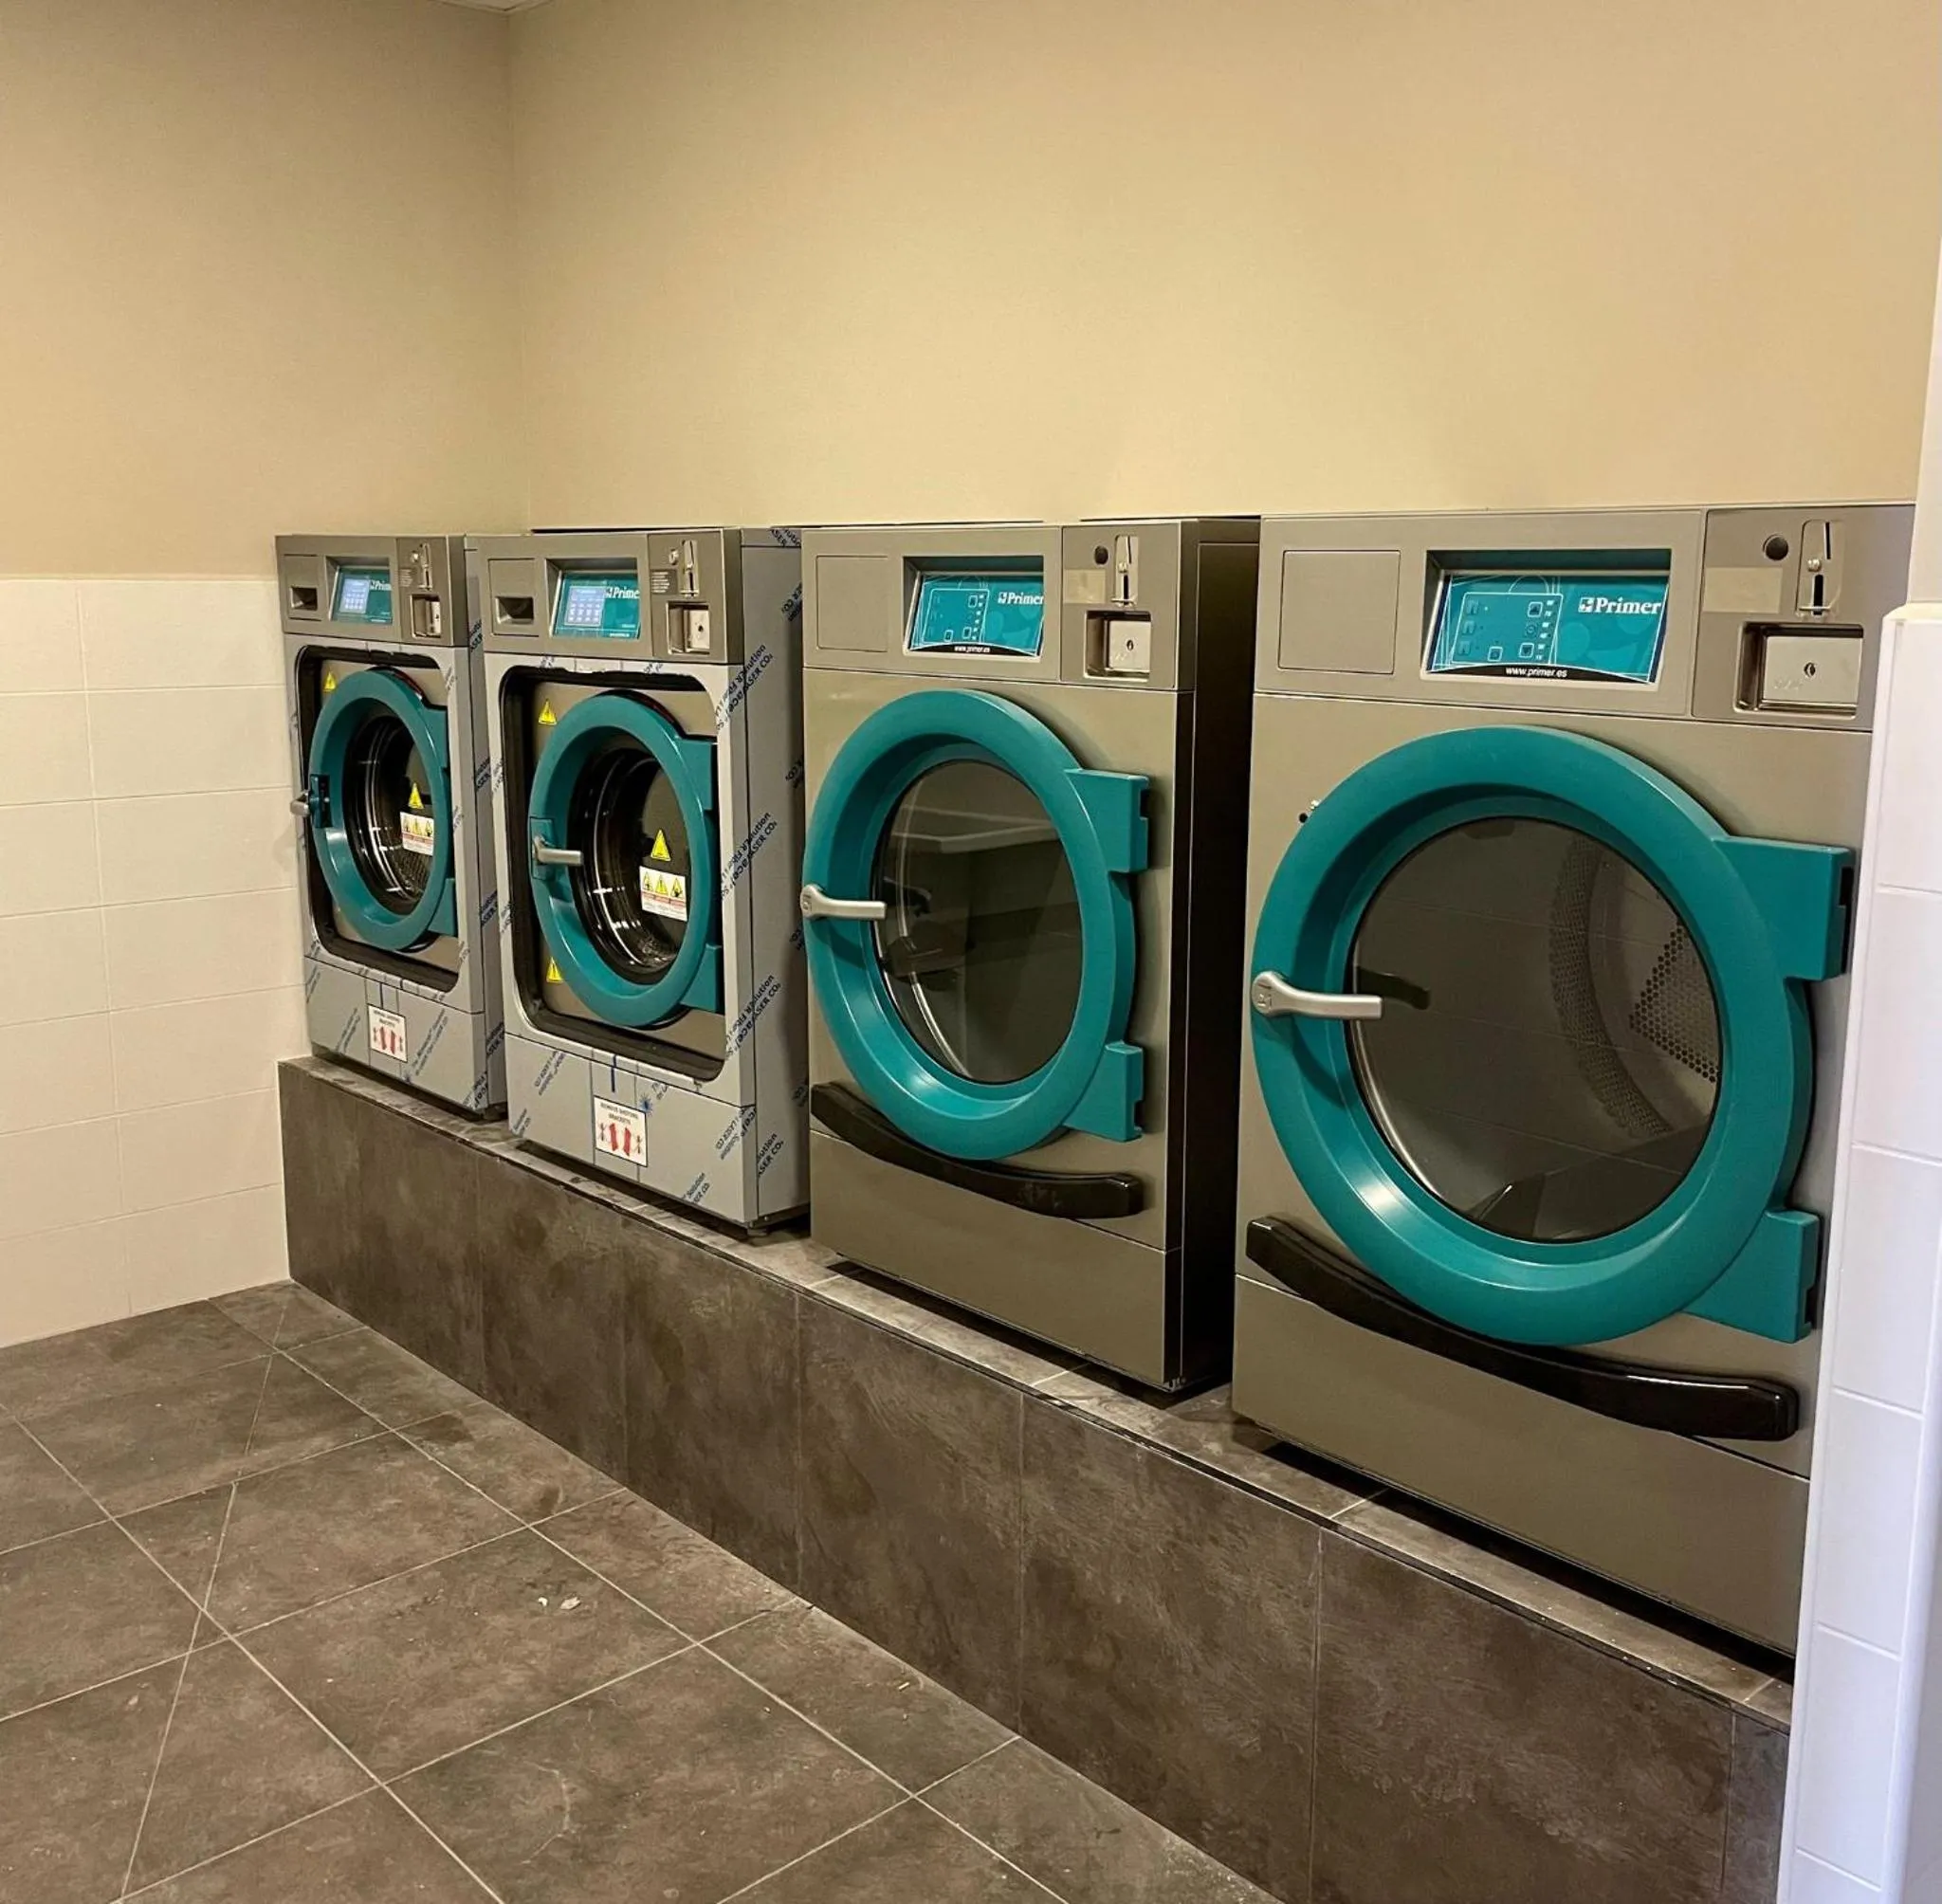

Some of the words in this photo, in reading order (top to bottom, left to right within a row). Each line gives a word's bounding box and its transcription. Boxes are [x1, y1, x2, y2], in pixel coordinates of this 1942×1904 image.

[612, 586, 641, 599] Prime
[1594, 595, 1662, 614] Primer
[1505, 667, 1568, 678] www.primer.es
